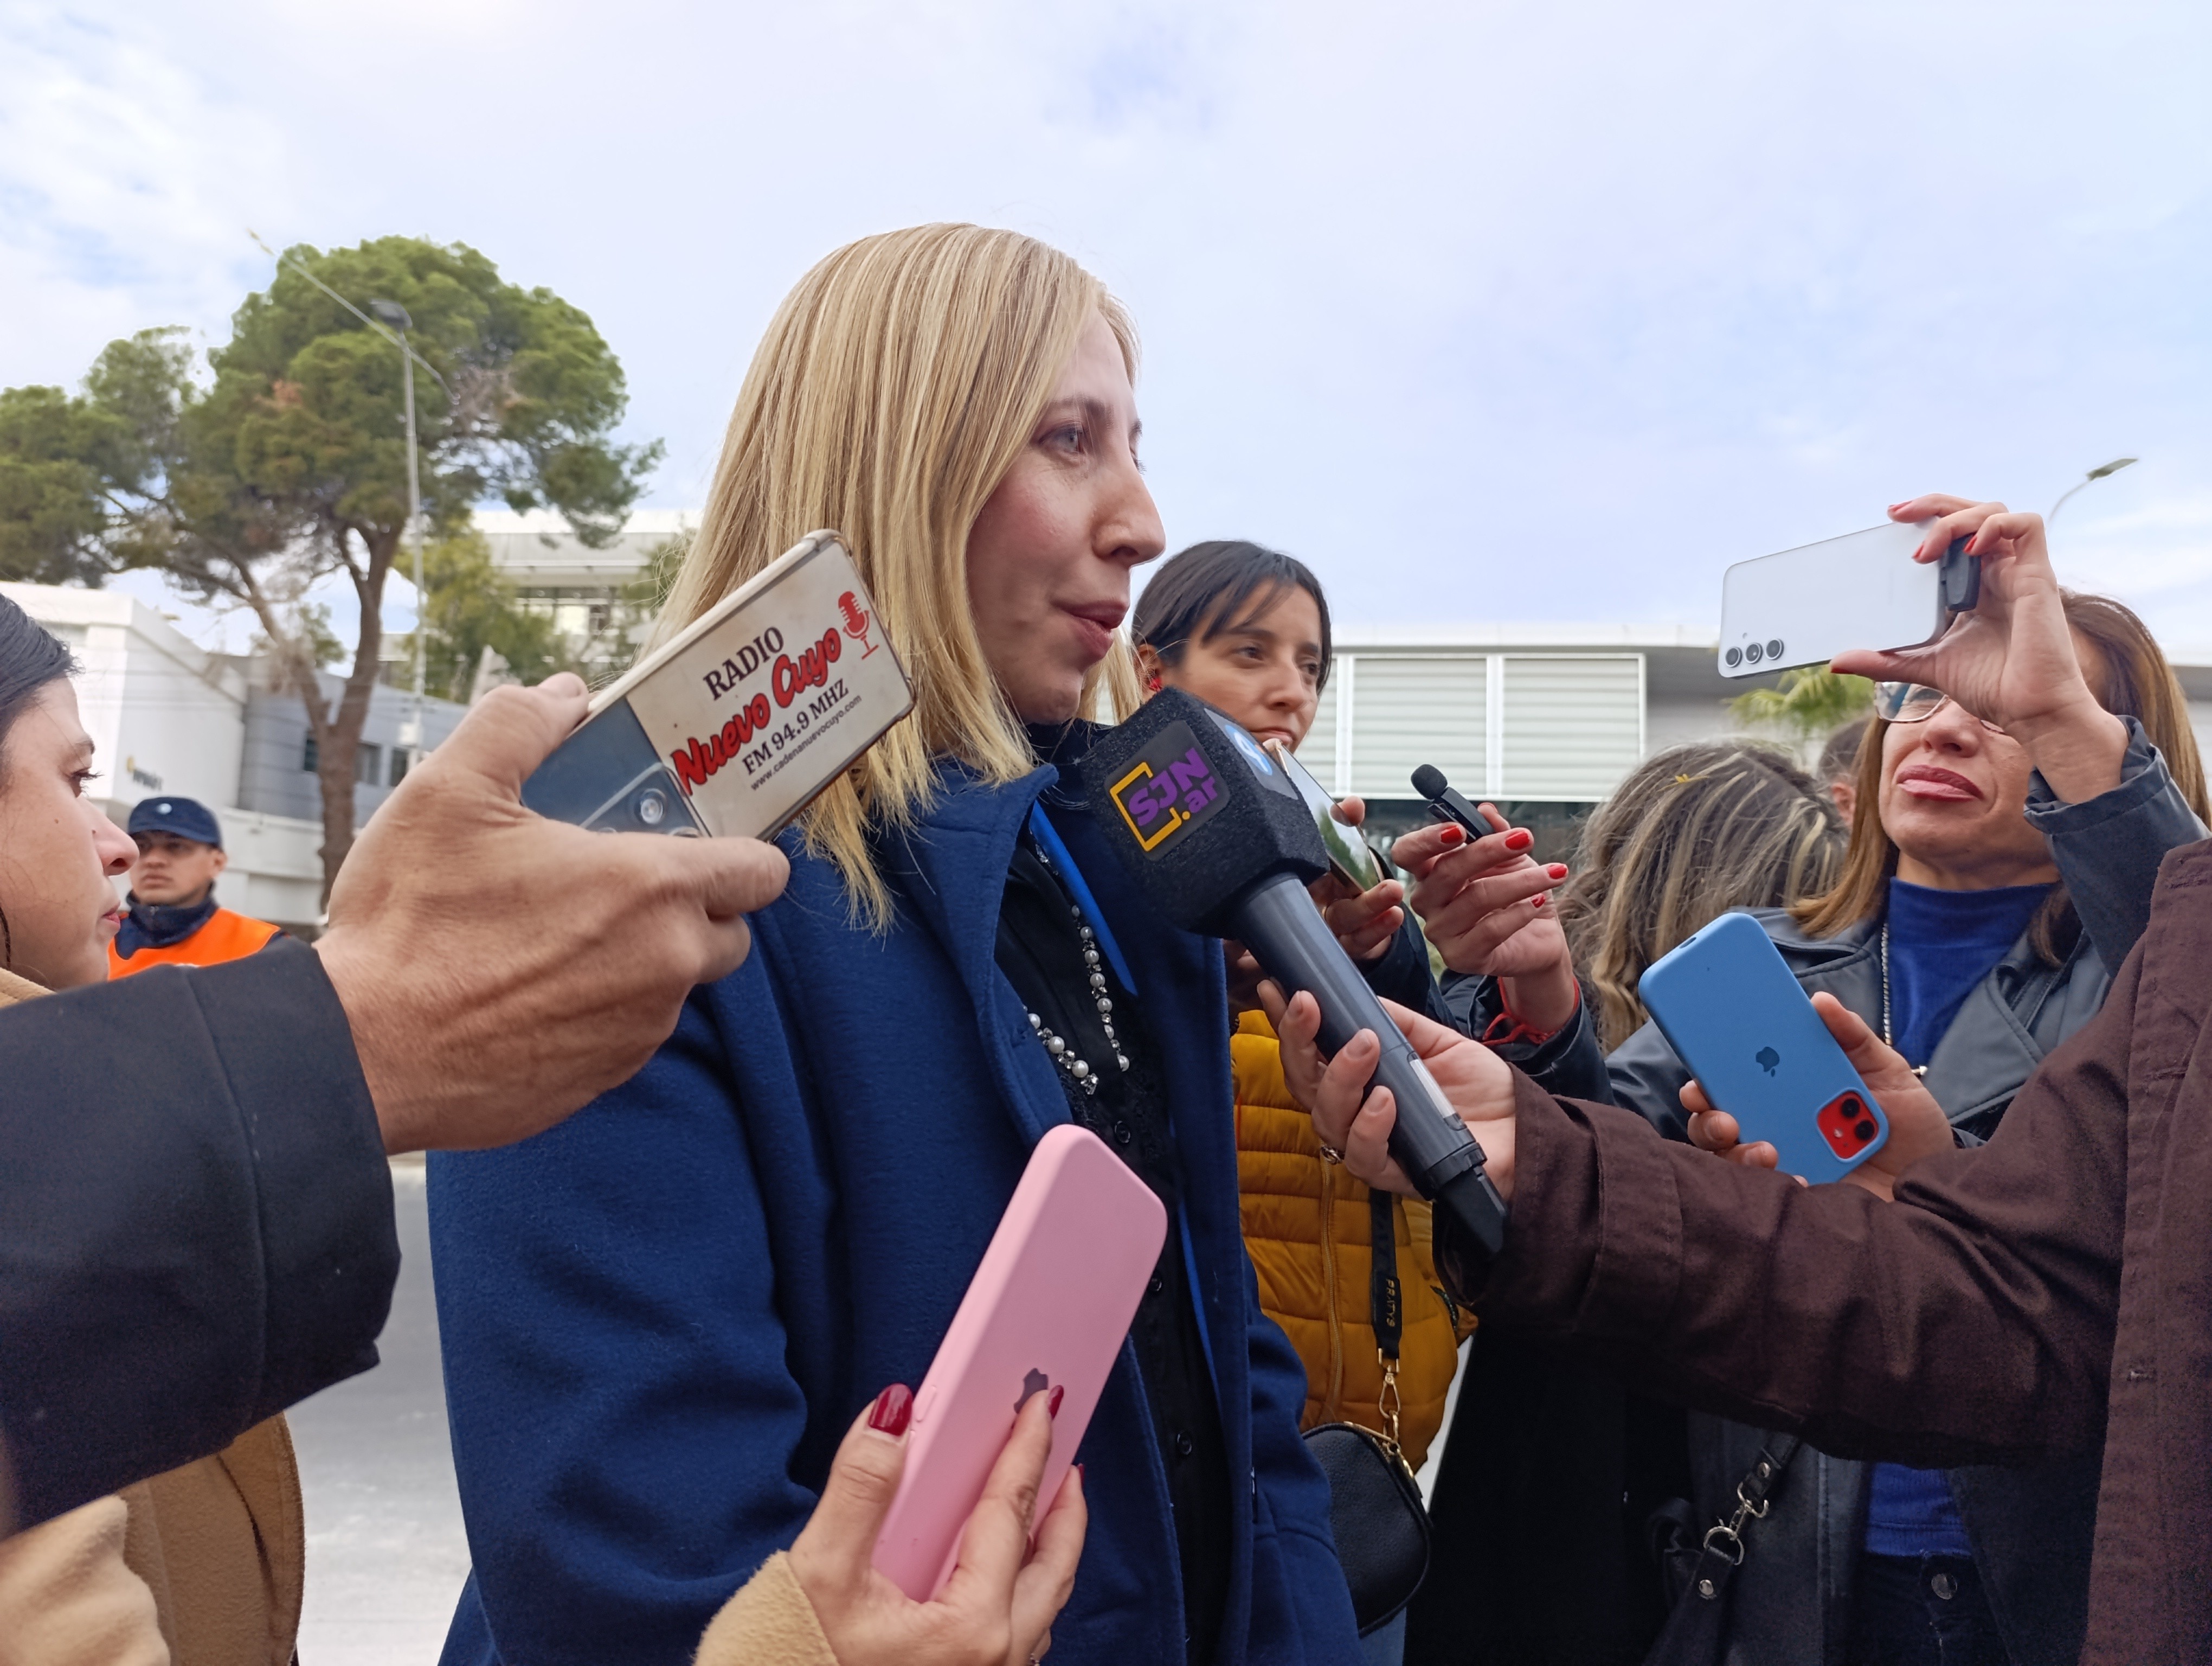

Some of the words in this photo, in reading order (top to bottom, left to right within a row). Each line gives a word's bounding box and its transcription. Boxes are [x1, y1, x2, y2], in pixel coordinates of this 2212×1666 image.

[670, 693, 771, 796] Nuevo
[772, 627, 842, 708] Cuyo
[703, 626, 784, 701] RADIO
[742, 741, 774, 776] FM
[771, 711, 811, 751] 94.9
[808, 678, 849, 720] MHZ
[750, 694, 863, 791] www.cadenanuevocuyo.com
[1128, 747, 1209, 826] SJN
